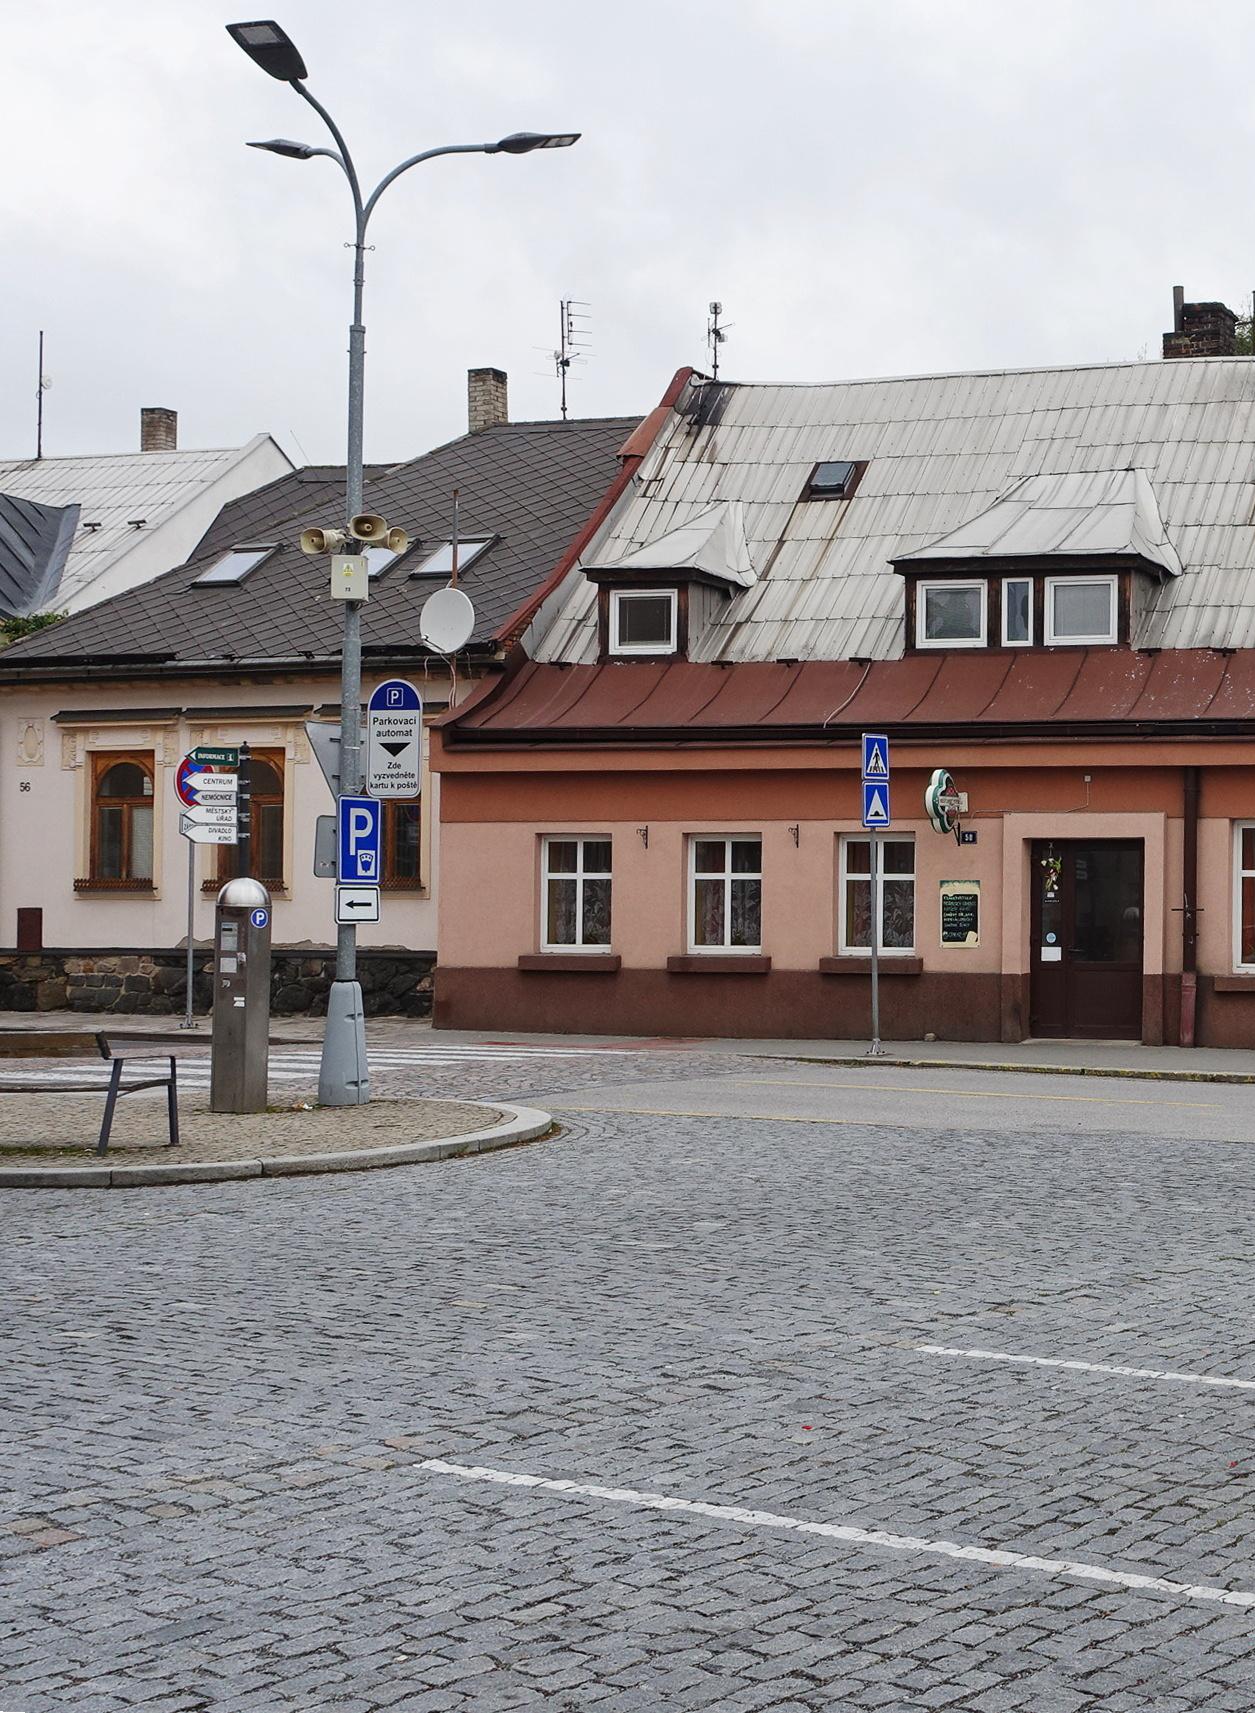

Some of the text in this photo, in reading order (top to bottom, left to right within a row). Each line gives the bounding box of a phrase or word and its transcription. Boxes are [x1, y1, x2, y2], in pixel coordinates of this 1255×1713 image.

[373, 716, 417, 726] Parkovací
[376, 729, 413, 737] automat
[387, 762, 402, 770] Zde
[373, 771, 416, 780] vyzvedněte
[20, 782, 31, 792] 56
[397, 781, 418, 790] poště
[349, 807, 374, 856] P
